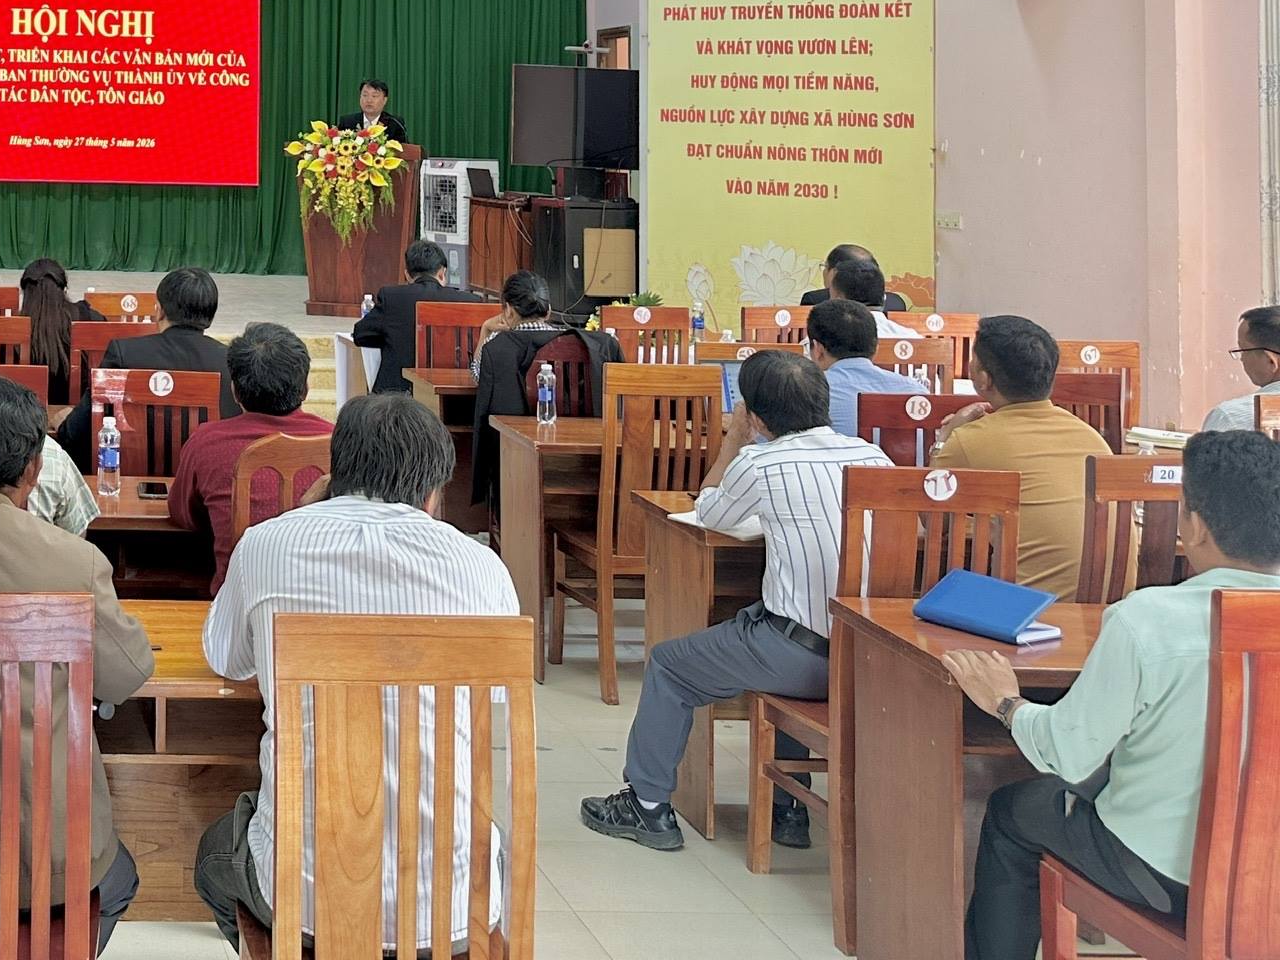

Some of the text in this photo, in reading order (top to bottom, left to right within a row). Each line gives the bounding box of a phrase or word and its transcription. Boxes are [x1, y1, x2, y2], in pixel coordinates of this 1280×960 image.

[663, 4, 696, 21] PHÁT
[700, 7, 726, 20] HUY
[731, 1, 783, 20] TRUYỀN
[787, 0, 834, 19] THỐNG
[839, 0, 880, 19] ĐOÀN
[10, 4, 155, 45] HỘI NGHỊ
[53, 49, 88, 64] KHAI
[91, 48, 120, 64] CÁC
[123, 48, 151, 65] VĂN
[155, 48, 182, 65] BẢN
[186, 49, 213, 66] MỚI
[217, 50, 246, 67] CỦA
[696, 37, 873, 58] VÀ KHÁT VỌNG VƯƠN LÊN;
[0, 69, 26, 82] BAN
[30, 68, 89, 83] THƯỜNG
[93, 70, 111, 86] VỤ
[115, 68, 162, 85] THÀNH
[209, 69, 250, 86] CÔNG
[691, 71, 879, 93] HUY ĐỘNG MỌI TIỀM NĂNG,
[0, 85, 165, 106] TÁC DÂN TỘC, TÔN GIÁO
[660, 104, 915, 129] NGUỒN LỰC XÂY DỰNG XÃ HÙNG SƠN
[9, 135, 32, 148] Hùng
[54, 136, 72, 148] ngày
[74, 137, 84, 146] 27
[85, 136, 108, 149] tháng
[117, 139, 134, 148] năm
[136, 139, 155, 148] 2026
[687, 139, 883, 164] ĐẠT CHUẨN NÔNG THÔN MỚI
[726, 177, 752, 195] VÀO
[757, 179, 790, 196] NĂM
[794, 183, 828, 199] 2030
[899, 345, 907, 356] 8
[1084, 348, 1097, 361] 67
[152, 375, 170, 392] 12
[910, 399, 927, 415] 18
[1160, 469, 1175, 480] 20
